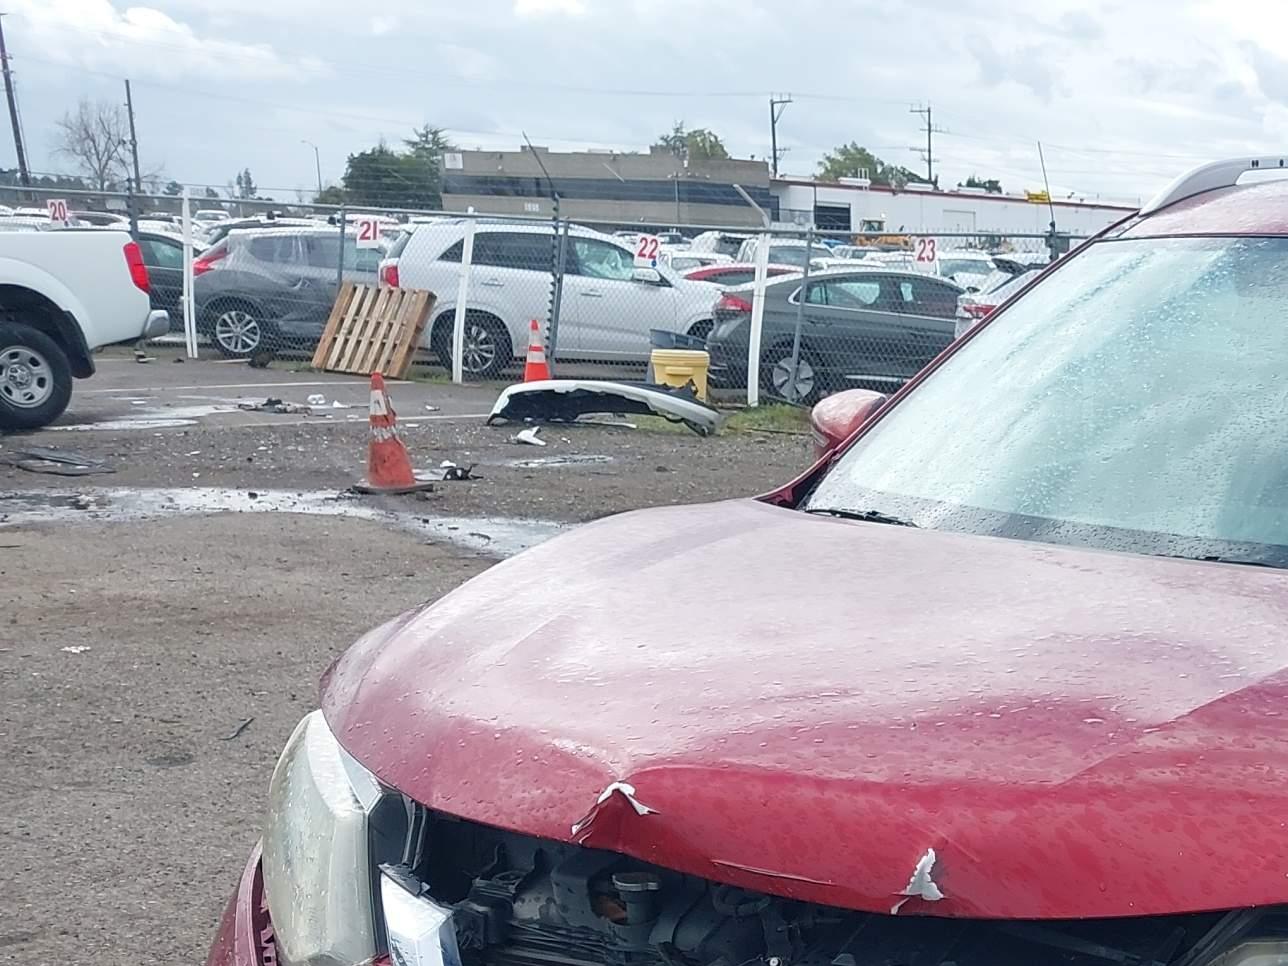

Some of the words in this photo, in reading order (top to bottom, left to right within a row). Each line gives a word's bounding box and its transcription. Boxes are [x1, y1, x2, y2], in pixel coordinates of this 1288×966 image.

[50, 201, 66, 221] 20
[359, 220, 378, 241] 21
[637, 236, 659, 260] 22
[917, 238, 936, 262] 23
